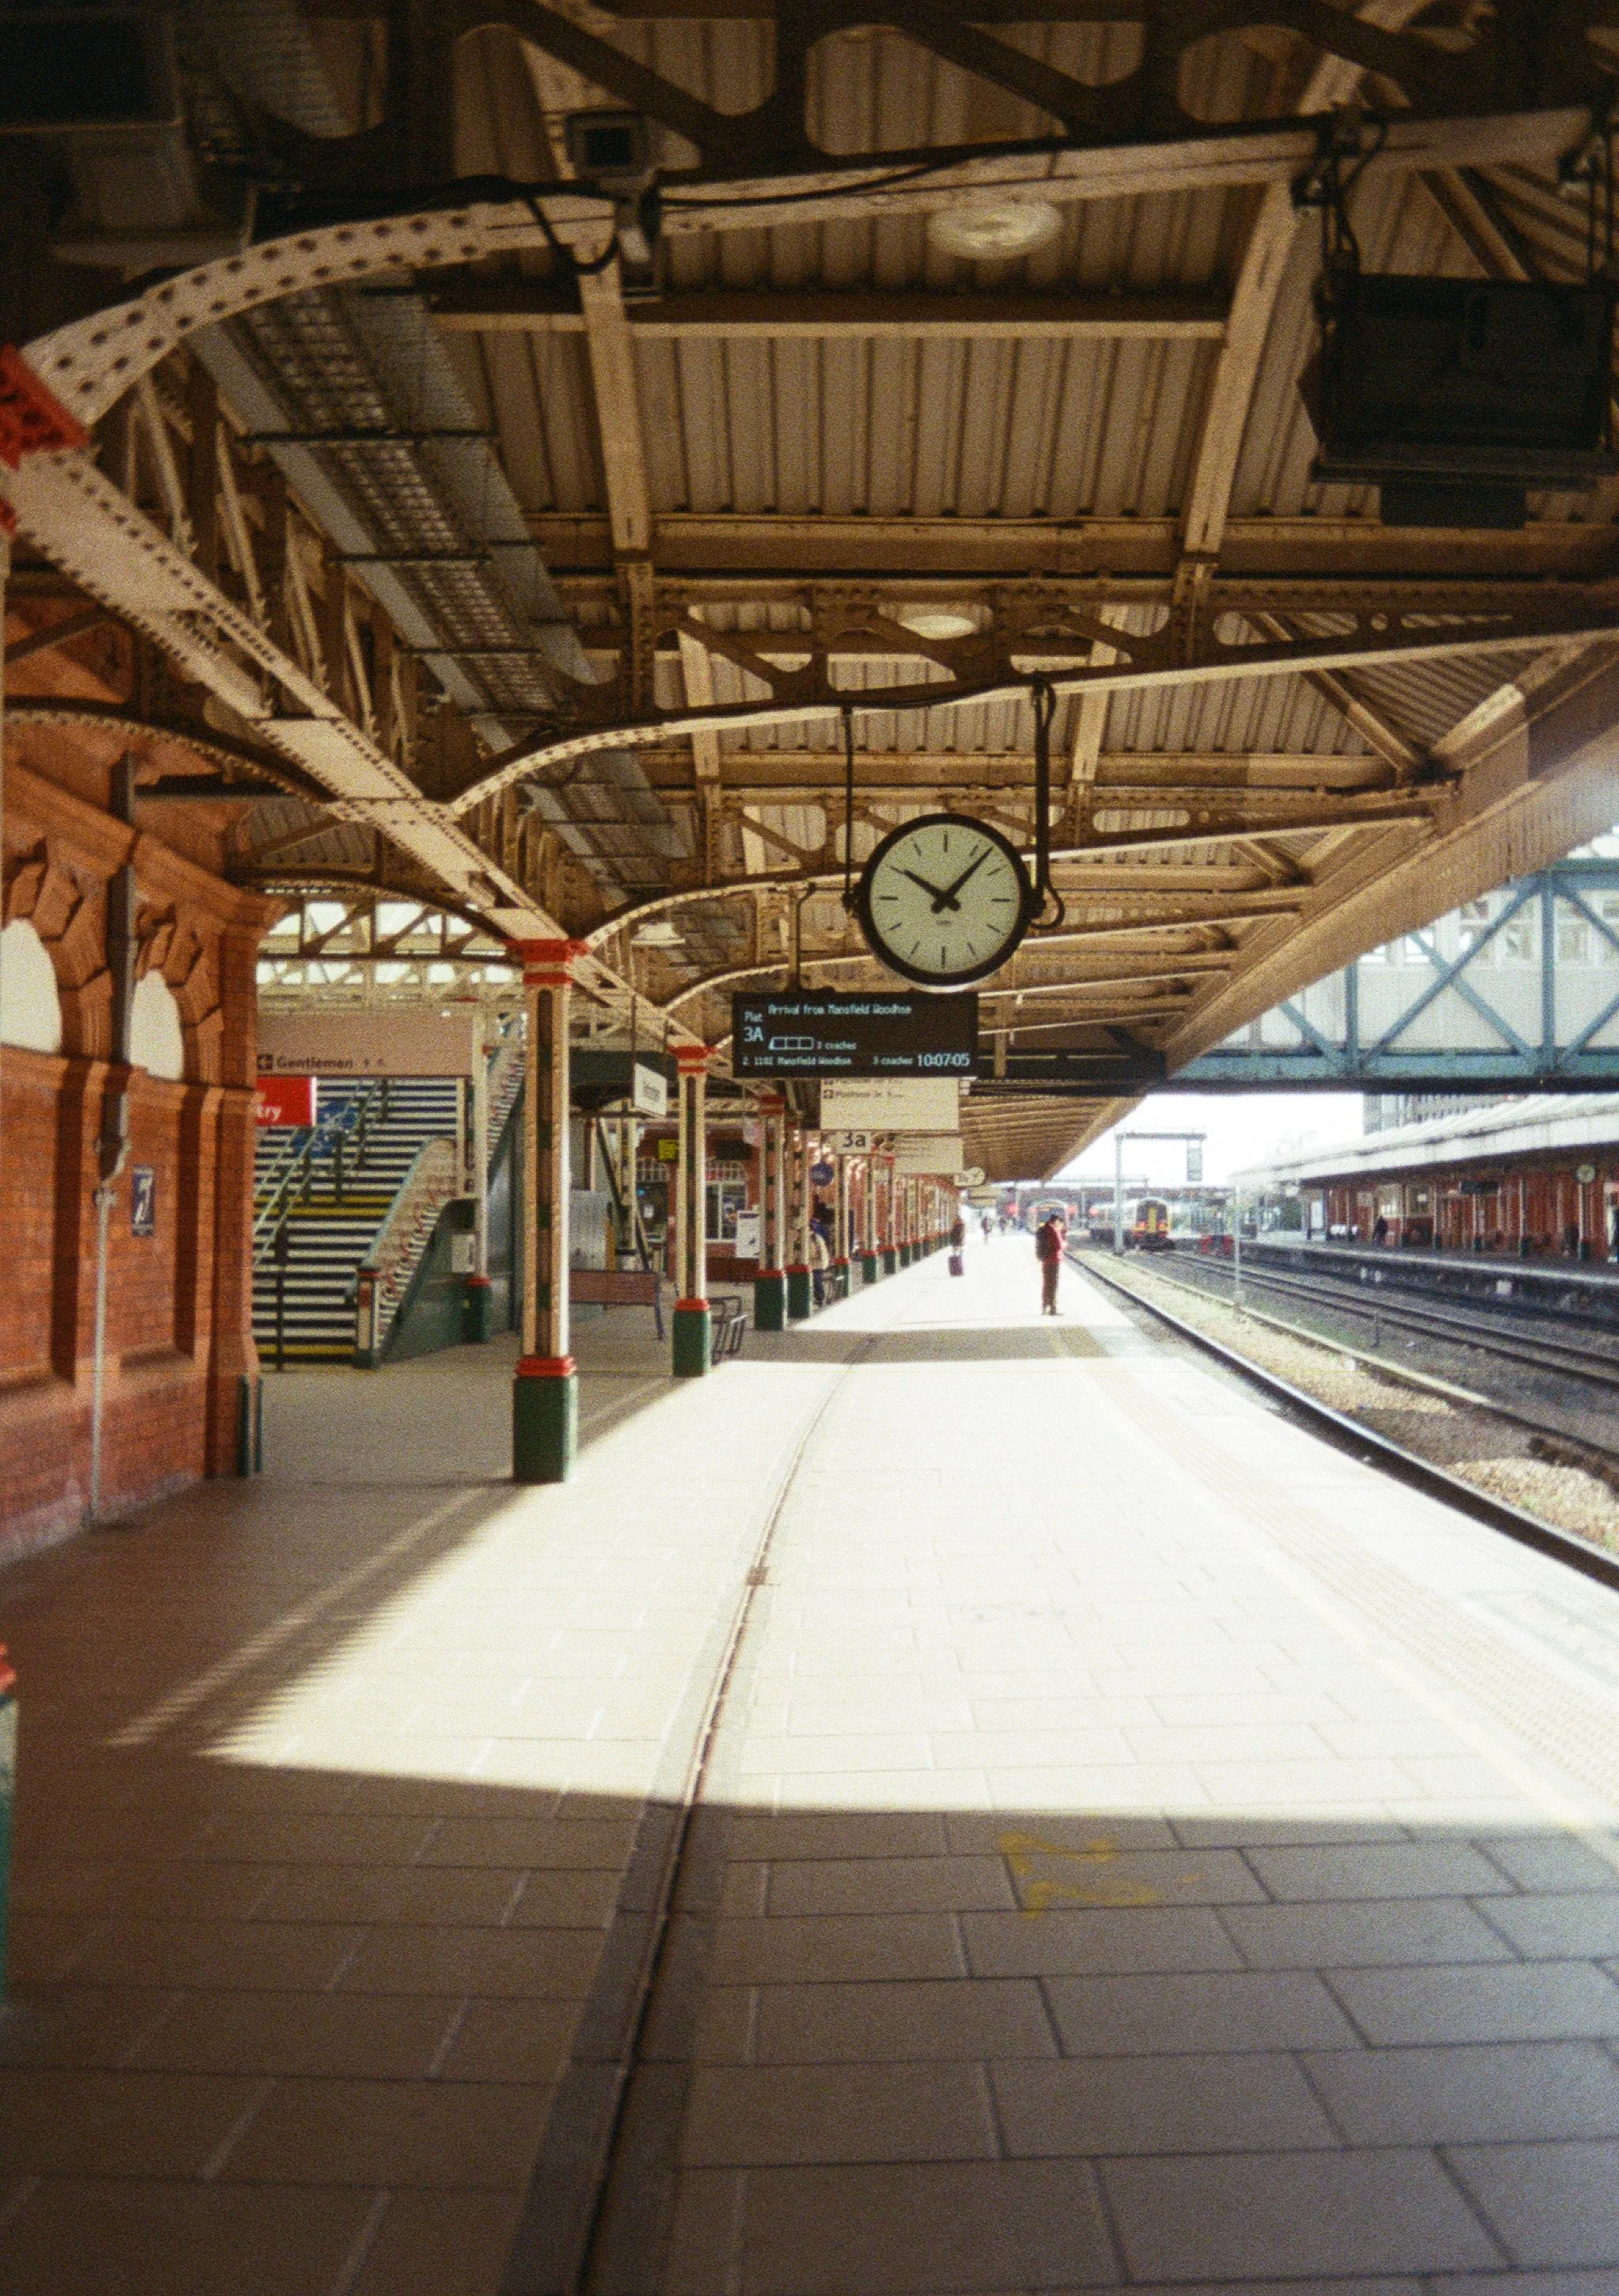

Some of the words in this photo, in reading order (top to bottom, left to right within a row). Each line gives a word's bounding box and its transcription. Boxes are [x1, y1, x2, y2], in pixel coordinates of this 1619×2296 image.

[745, 1011, 763, 1022] Plat
[743, 1027, 764, 1042] 3A
[277, 1056, 353, 1069] Gentlemen
[917, 1053, 970, 1067] 10:07:05
[843, 1132, 866, 1148] 3a
